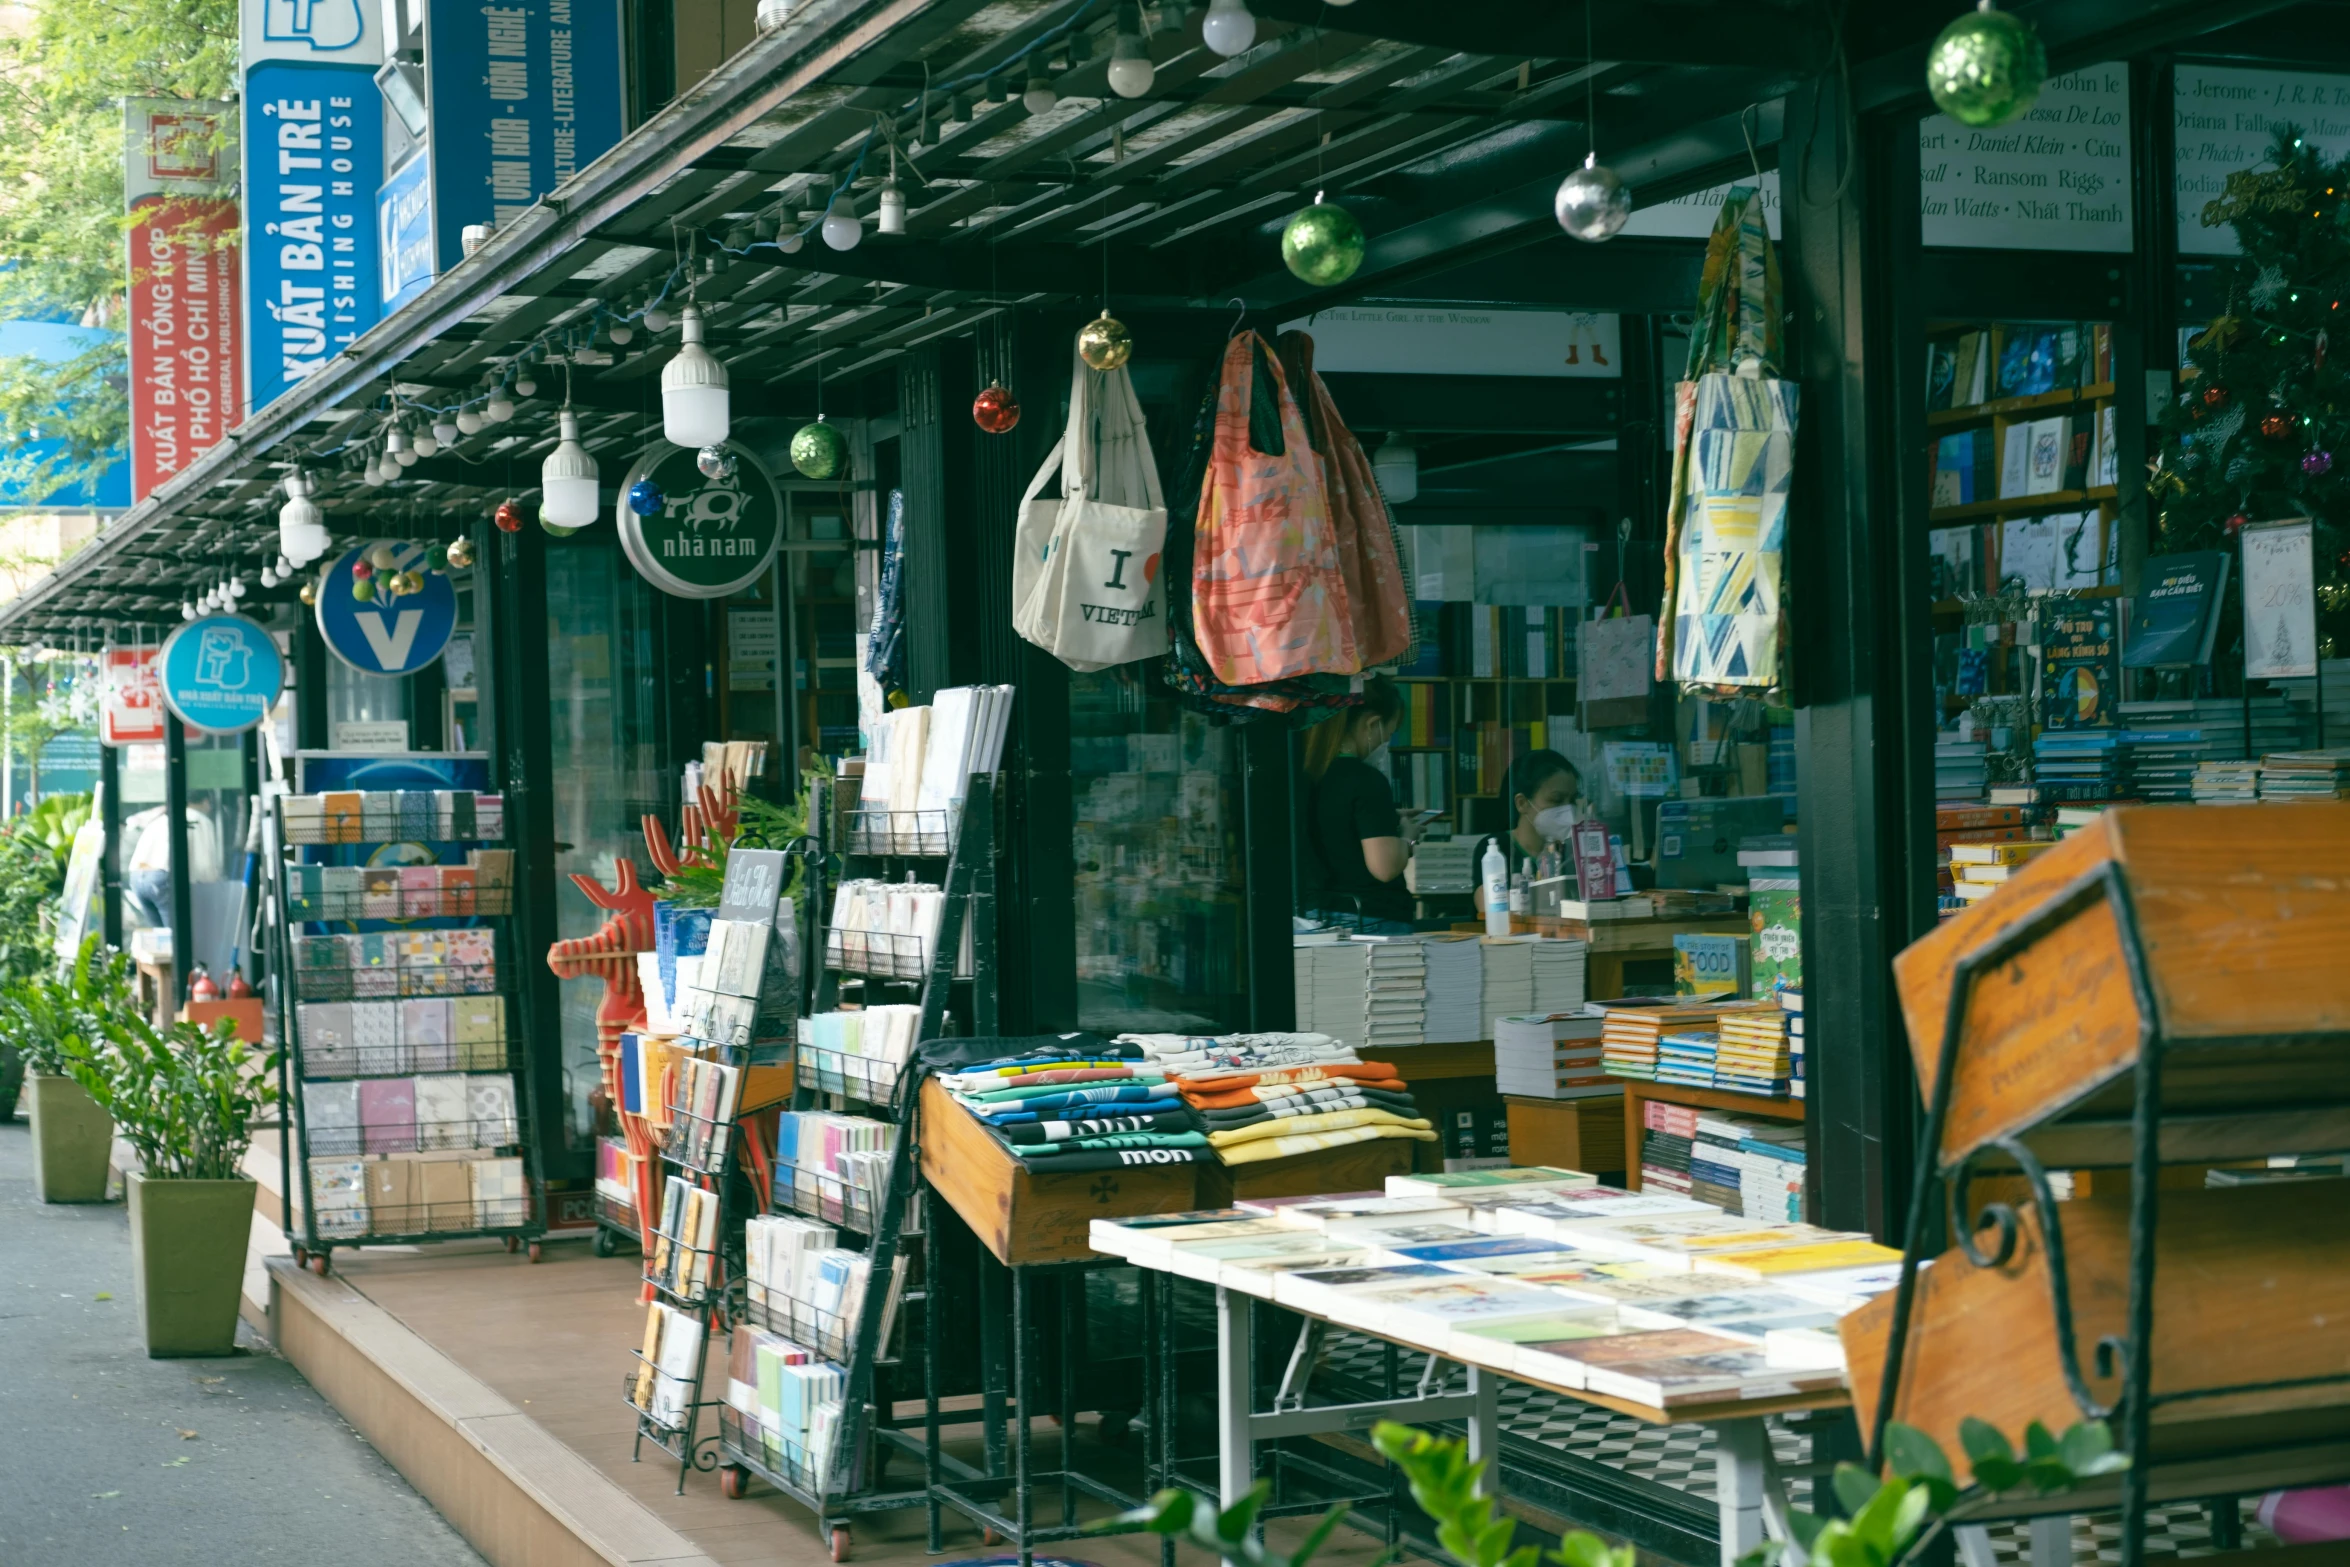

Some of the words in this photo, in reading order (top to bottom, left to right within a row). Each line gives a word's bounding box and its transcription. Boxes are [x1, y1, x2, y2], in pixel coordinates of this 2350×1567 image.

[480, 6, 535, 57] NGHỆ
[549, 0, 572, 25] AN
[481, 61, 529, 101] VĂN
[2052, 73, 2098, 93] John
[2104, 73, 2121, 94] le
[2193, 78, 2258, 101] Jerome
[2273, 84, 2286, 108] J.
[2291, 84, 2306, 104] R.
[2312, 86, 2327, 105] R.
[2065, 104, 2088, 125] De
[2090, 105, 2122, 126] Loo
[262, 98, 323, 175] TRẺ
[329, 96, 354, 197] HOUSE
[484, 117, 531, 157] HÓA
[1966, 131, 2023, 154] Daniel
[2022, 134, 2066, 156] Klein
[2176, 146, 2193, 164] ọc
[2197, 142, 2245, 164] Phách
[485, 160, 532, 200] VĂN
[1973, 164, 2049, 188] Ransom
[2057, 168, 2106, 196] Riggs
[264, 184, 324, 272] BẢN
[1953, 196, 2001, 219] Watts
[2015, 198, 2061, 221] Nhất
[2066, 200, 2124, 223] Thanh
[217, 232, 230, 276] HOUE
[331, 213, 356, 356] LISHING
[141, 283, 175, 351] TỔNG
[181, 297, 210, 342] CHÍ
[218, 278, 232, 355] PUBLISHING
[265, 279, 327, 384] XUẤT
[145, 355, 176, 407] BẢN
[180, 349, 211, 384] HỒ
[219, 357, 233, 416] GENERAL
[180, 387, 212, 447] PHỐ
[146, 411, 178, 475] XUẤT
[663, 531, 705, 557] nhã
[710, 538, 756, 556] nam
[1104, 549, 1132, 590] I
[2260, 582, 2302, 609] -20%
[353, 608, 425, 671] V
[1687, 951, 1731, 973] FOOD
[1118, 1149, 1194, 1165] mon
